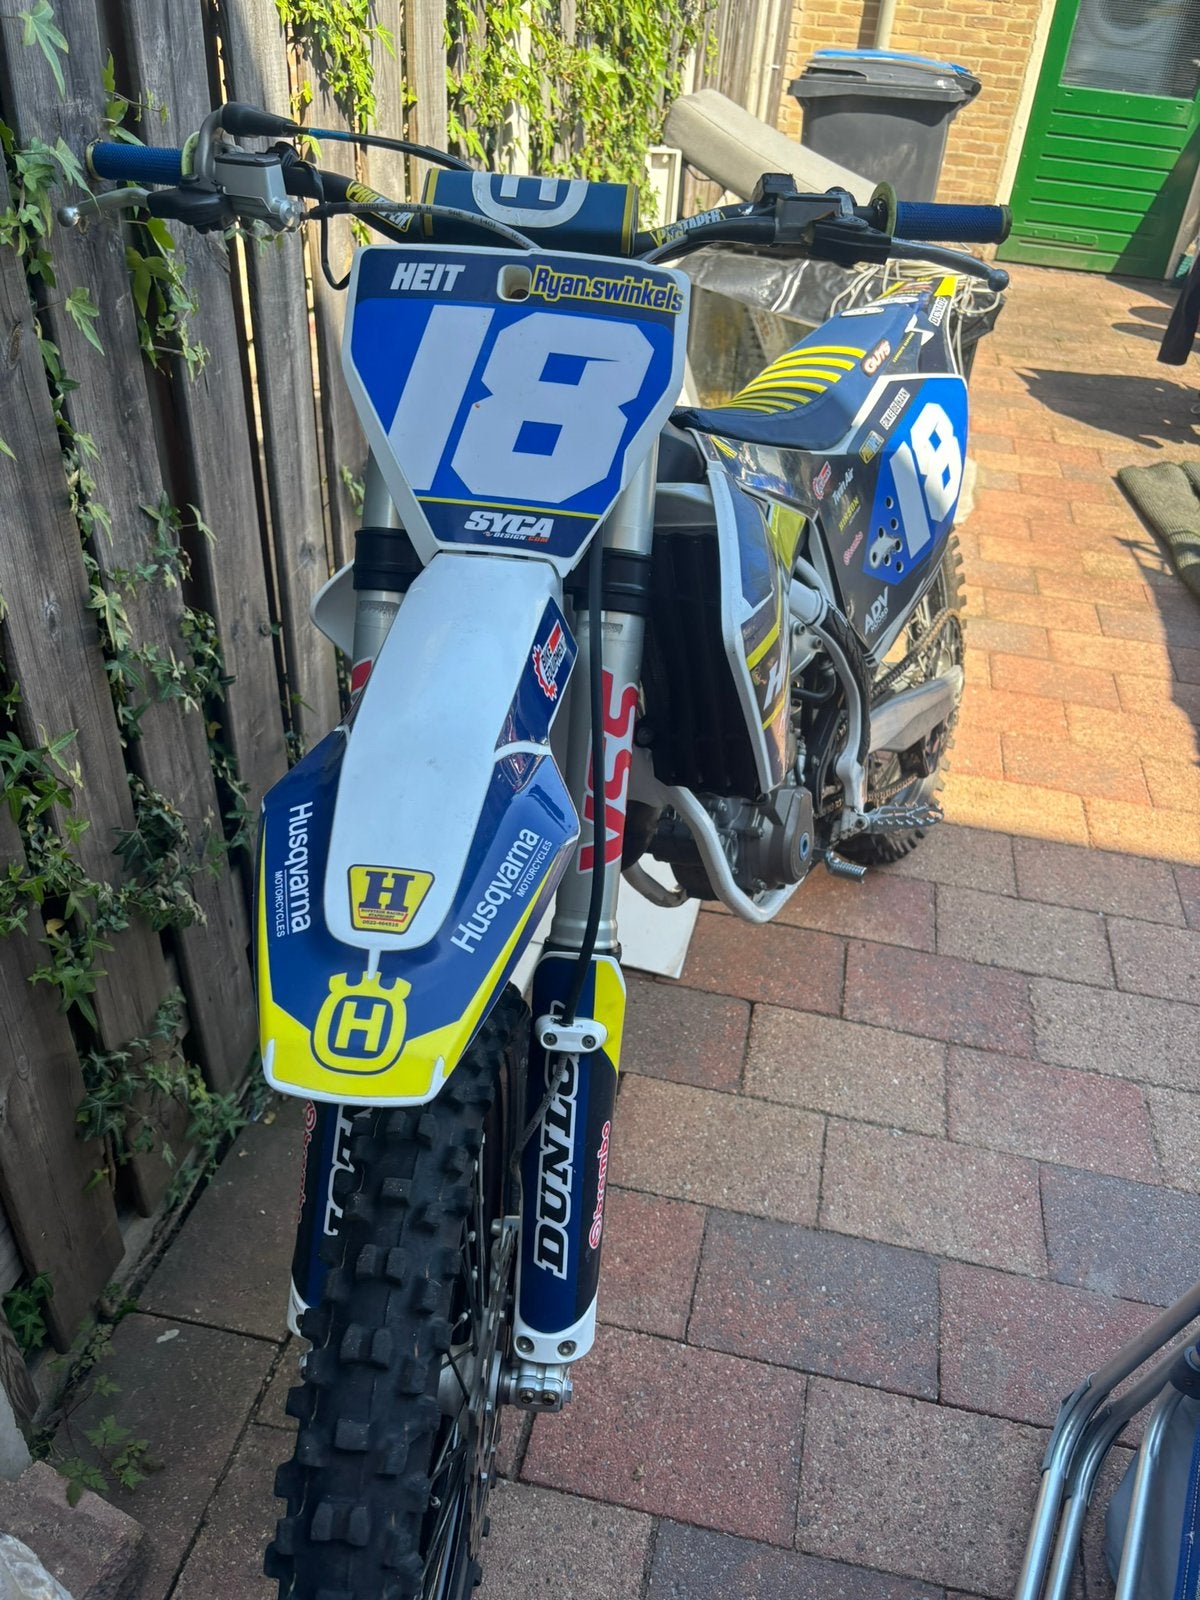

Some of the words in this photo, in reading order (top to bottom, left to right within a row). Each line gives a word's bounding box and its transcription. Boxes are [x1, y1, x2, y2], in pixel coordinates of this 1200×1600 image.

[390, 262, 466, 292] HEIT
[533, 265, 684, 313] Ryan.swinkels
[388, 304, 655, 503] 18
[889, 402, 963, 559] 18
[464, 511, 554, 537] SYCA
[865, 586, 888, 635] ADV
[284, 801, 313, 934] Husqvarna
[358, 870, 415, 912] H
[450, 828, 540, 954] Husqvarna
[516, 840, 552, 897] MOTORCYCLES
[274, 870, 286, 938] MOTORCYCLES
[592, 1119, 611, 1224] brembo
